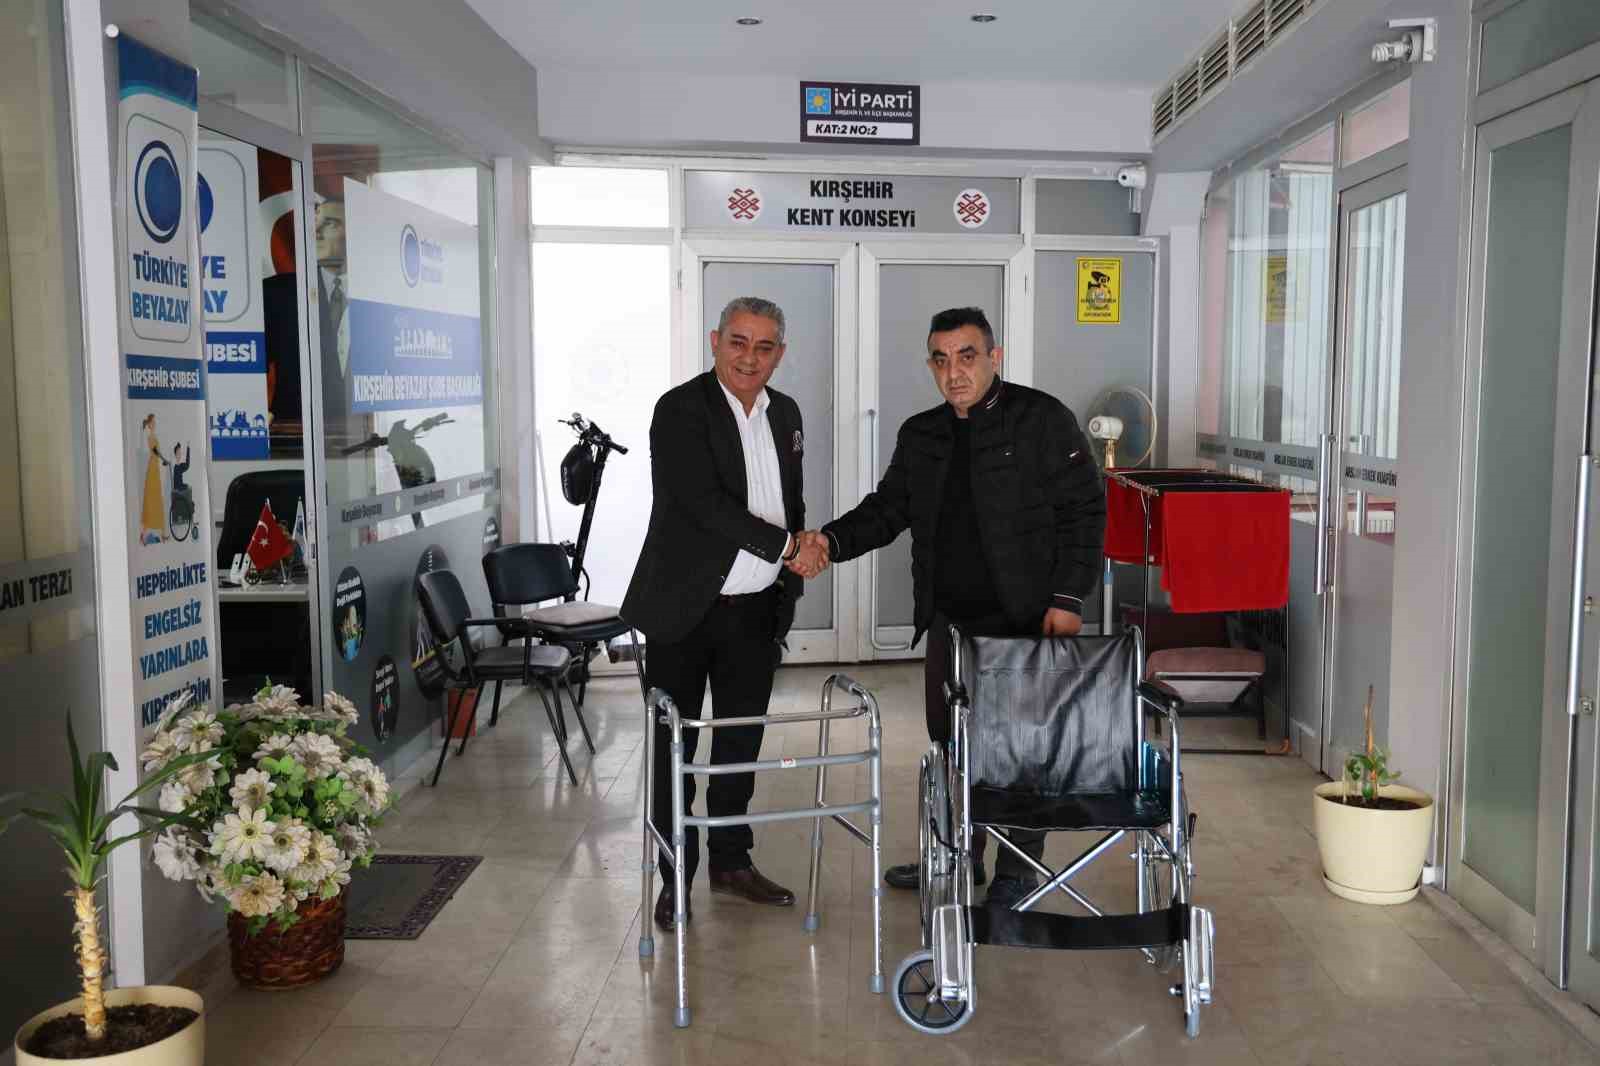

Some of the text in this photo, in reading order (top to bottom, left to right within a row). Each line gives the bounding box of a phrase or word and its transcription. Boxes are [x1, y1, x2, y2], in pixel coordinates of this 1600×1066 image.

[834, 87, 913, 109] İYİ PARTİ
[815, 124, 878, 135] KAT:2 NO:2
[787, 208, 834, 226] KENT
[133, 251, 188, 288] TÜRKİYE
[132, 291, 189, 325] BEYAZAY
[128, 366, 200, 391] KIRŞEHİR ŞUBESİ
[136, 562, 206, 599] HEPBİRLİKTE
[144, 597, 202, 640] ENGELSİZ
[140, 636, 209, 680] YARINLARA
